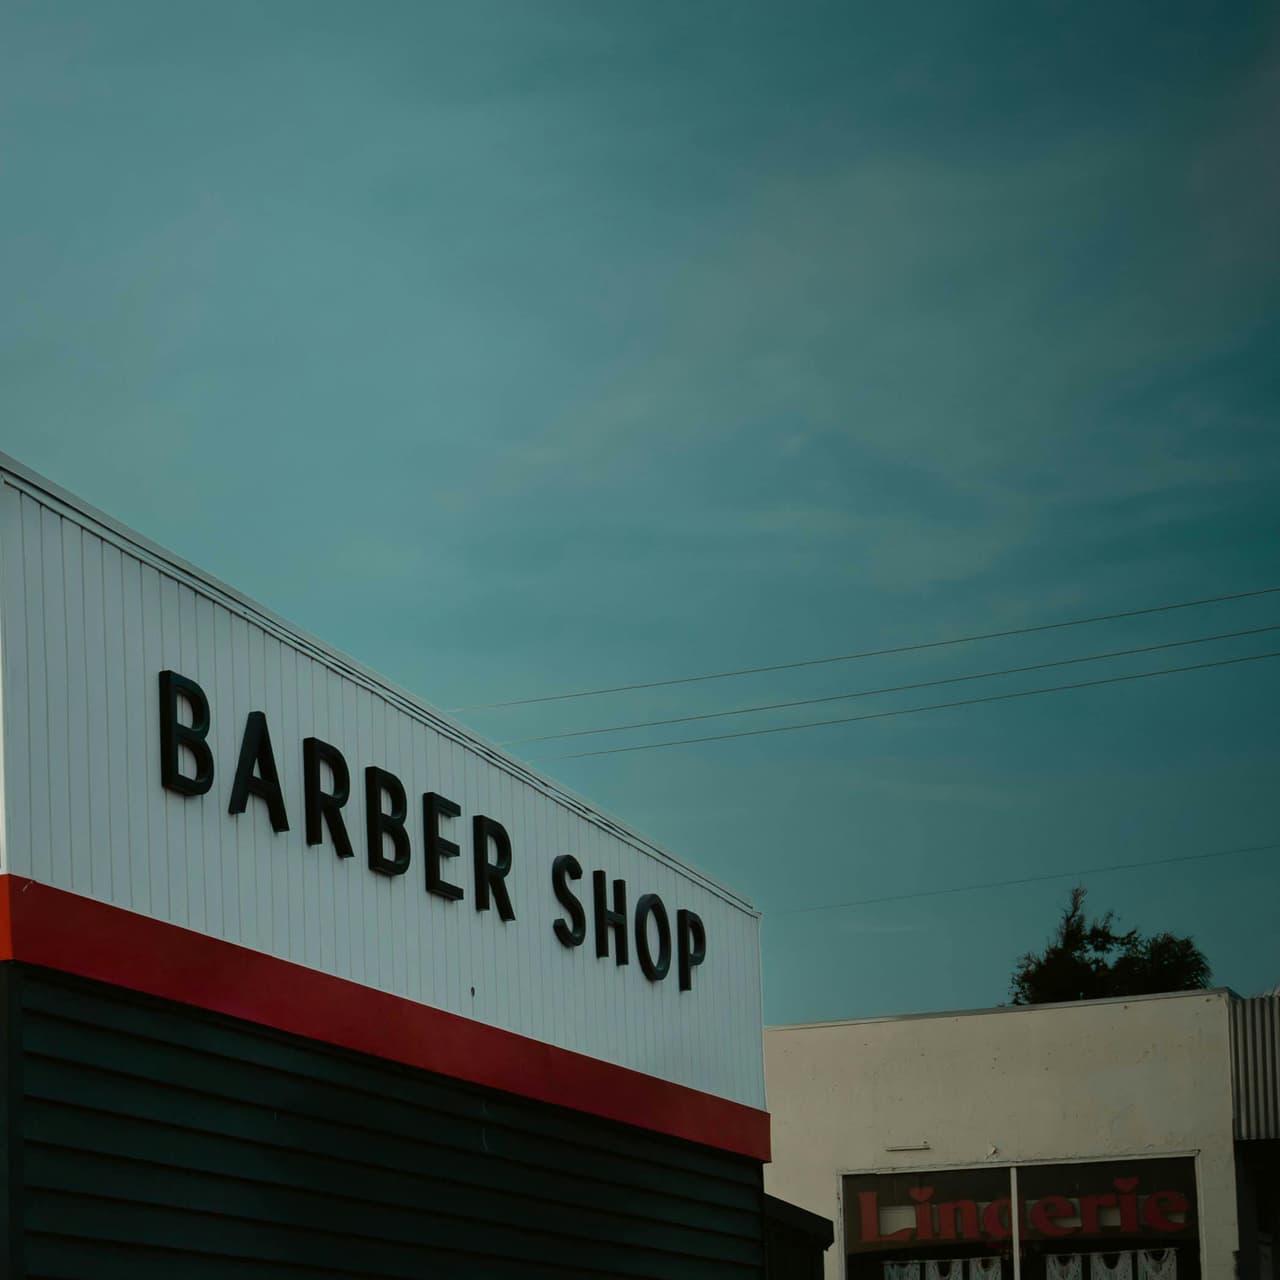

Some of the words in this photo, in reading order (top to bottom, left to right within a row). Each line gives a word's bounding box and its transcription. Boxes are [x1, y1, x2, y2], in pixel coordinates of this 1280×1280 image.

[159, 670, 516, 921] BARBER
[552, 854, 707, 991] SHOP
[858, 1176, 1190, 1250] Lingerie
